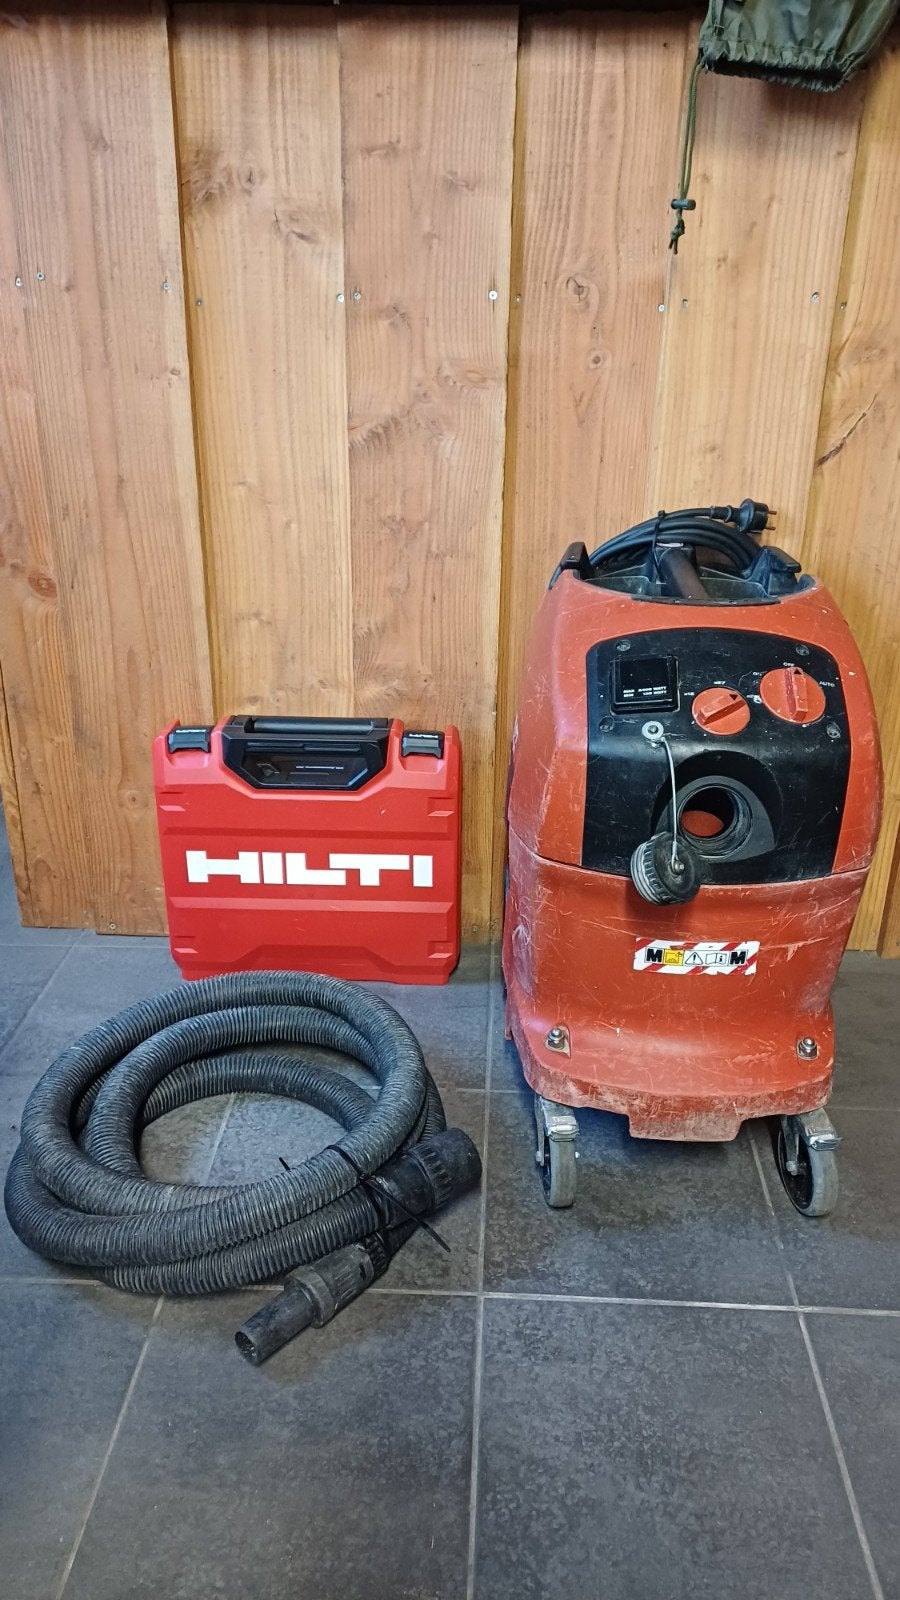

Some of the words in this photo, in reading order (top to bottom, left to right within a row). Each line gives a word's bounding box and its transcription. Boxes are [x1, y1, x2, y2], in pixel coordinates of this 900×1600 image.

[818, 680, 836, 688] AUTO
[186, 850, 434, 887] HILTI
[646, 948, 663, 963] M
[730, 951, 746, 965] M
